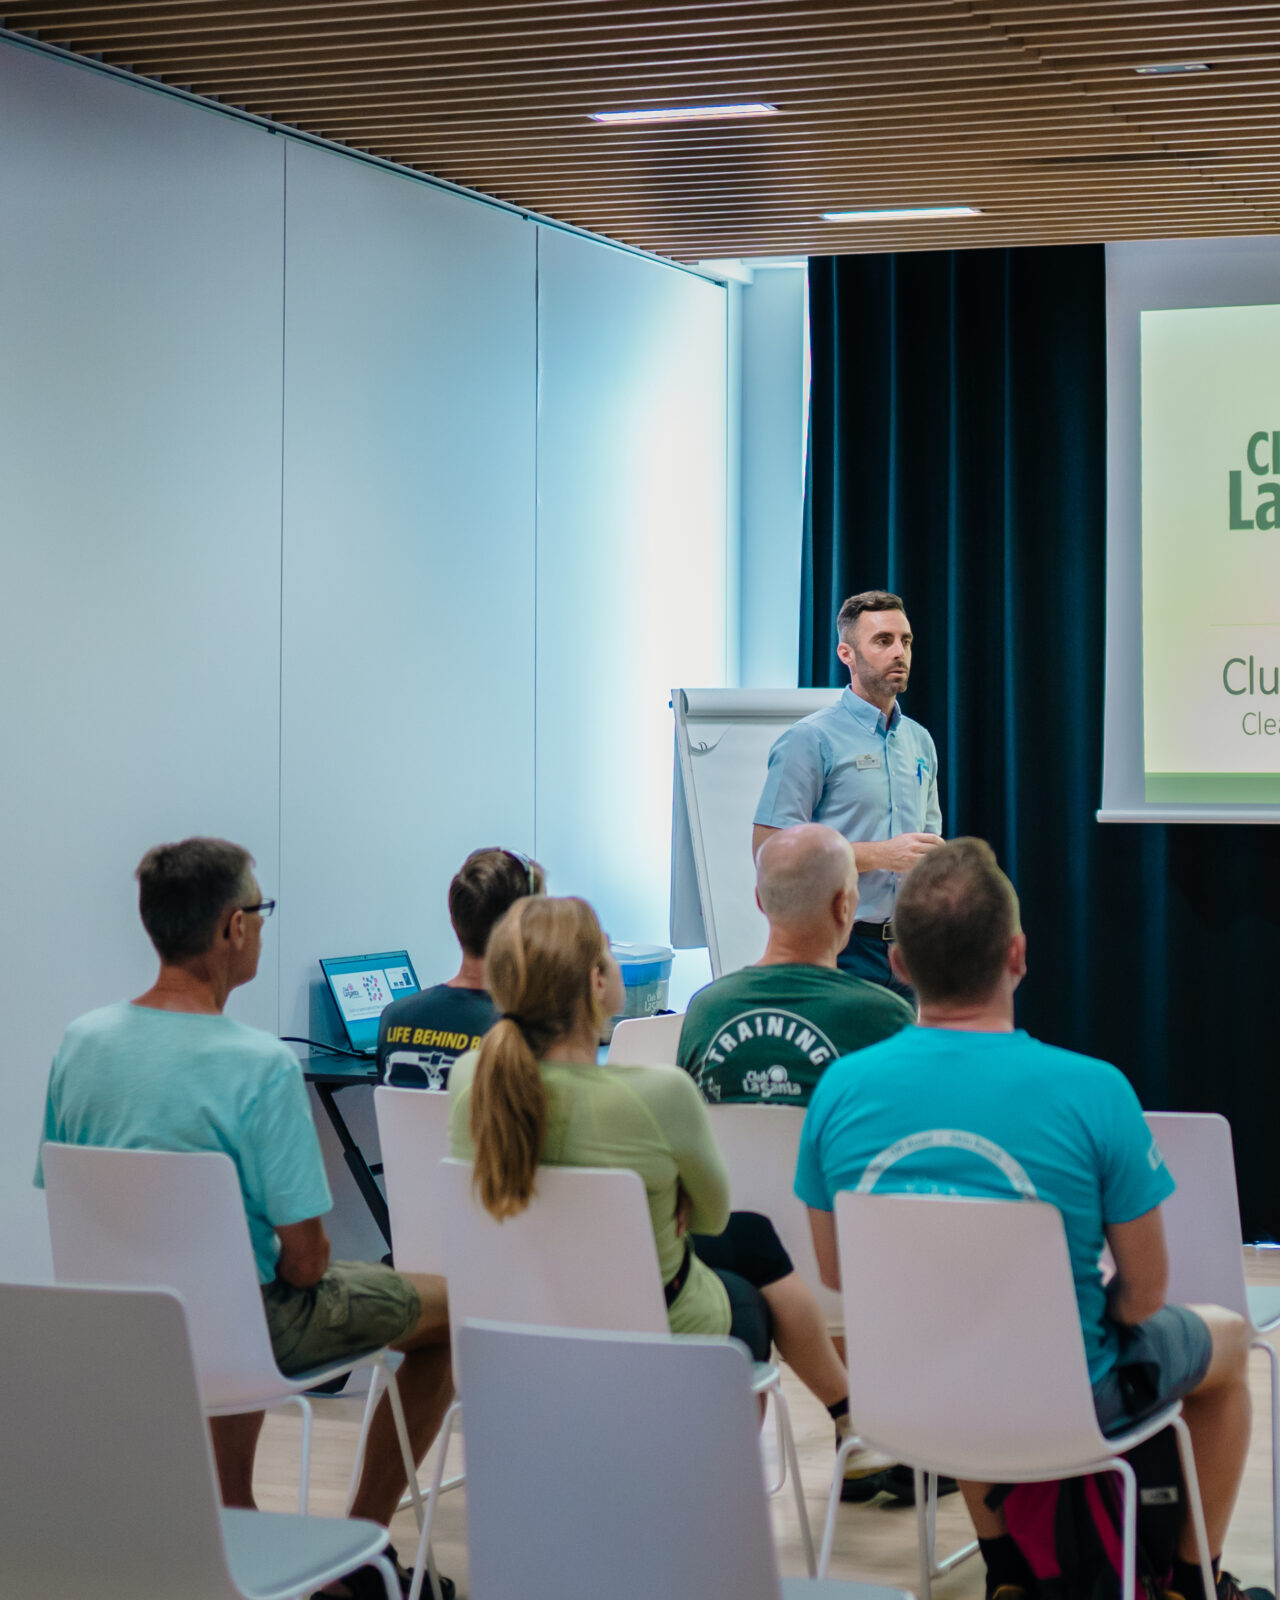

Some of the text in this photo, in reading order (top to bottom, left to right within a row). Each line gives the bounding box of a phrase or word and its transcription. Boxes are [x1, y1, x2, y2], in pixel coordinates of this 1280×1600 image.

[386, 1026, 412, 1044] LIFE
[412, 1028, 469, 1050] BEHIND
[708, 1015, 831, 1066] TRAINING
